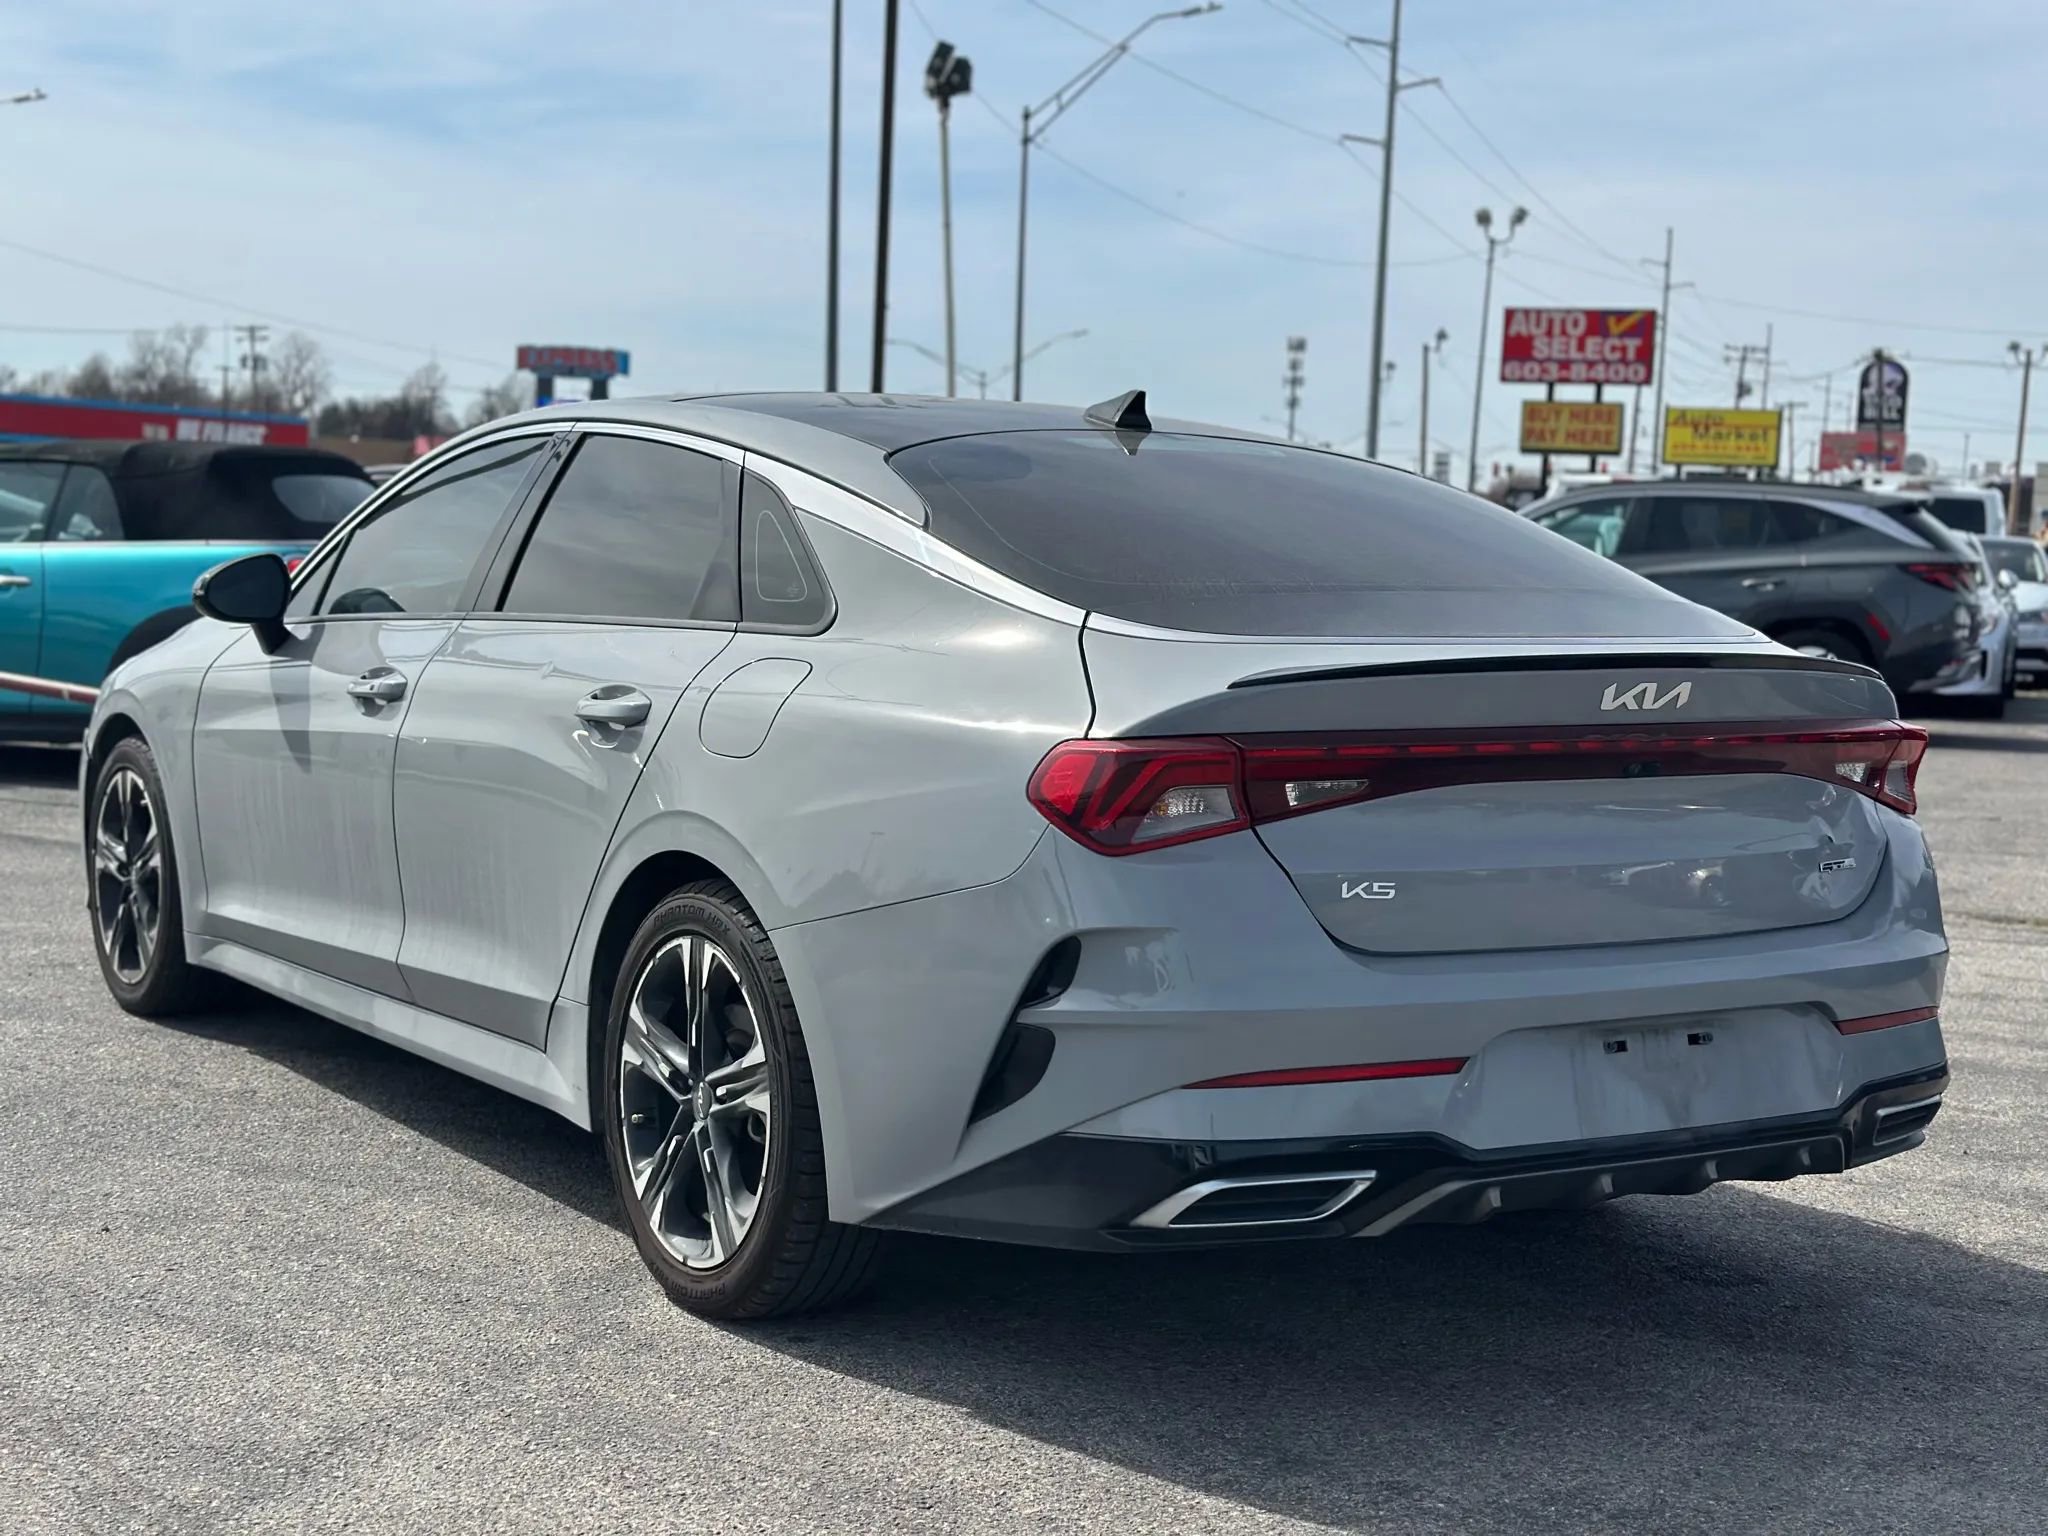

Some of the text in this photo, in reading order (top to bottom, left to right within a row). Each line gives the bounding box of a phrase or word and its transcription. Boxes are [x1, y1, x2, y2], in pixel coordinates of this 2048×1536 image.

[1508, 311, 1587, 336] AUTO
[1532, 336, 1642, 361] SELECT
[1503, 360, 1647, 381] 603-8400
[1527, 405, 1616, 424] BUY HERE
[1671, 408, 1724, 427] Auto
[1526, 427, 1614, 446] PAY HERE
[1691, 424, 1768, 443] Market
[1600, 681, 1692, 710] KIA
[1341, 881, 1396, 899] K5
